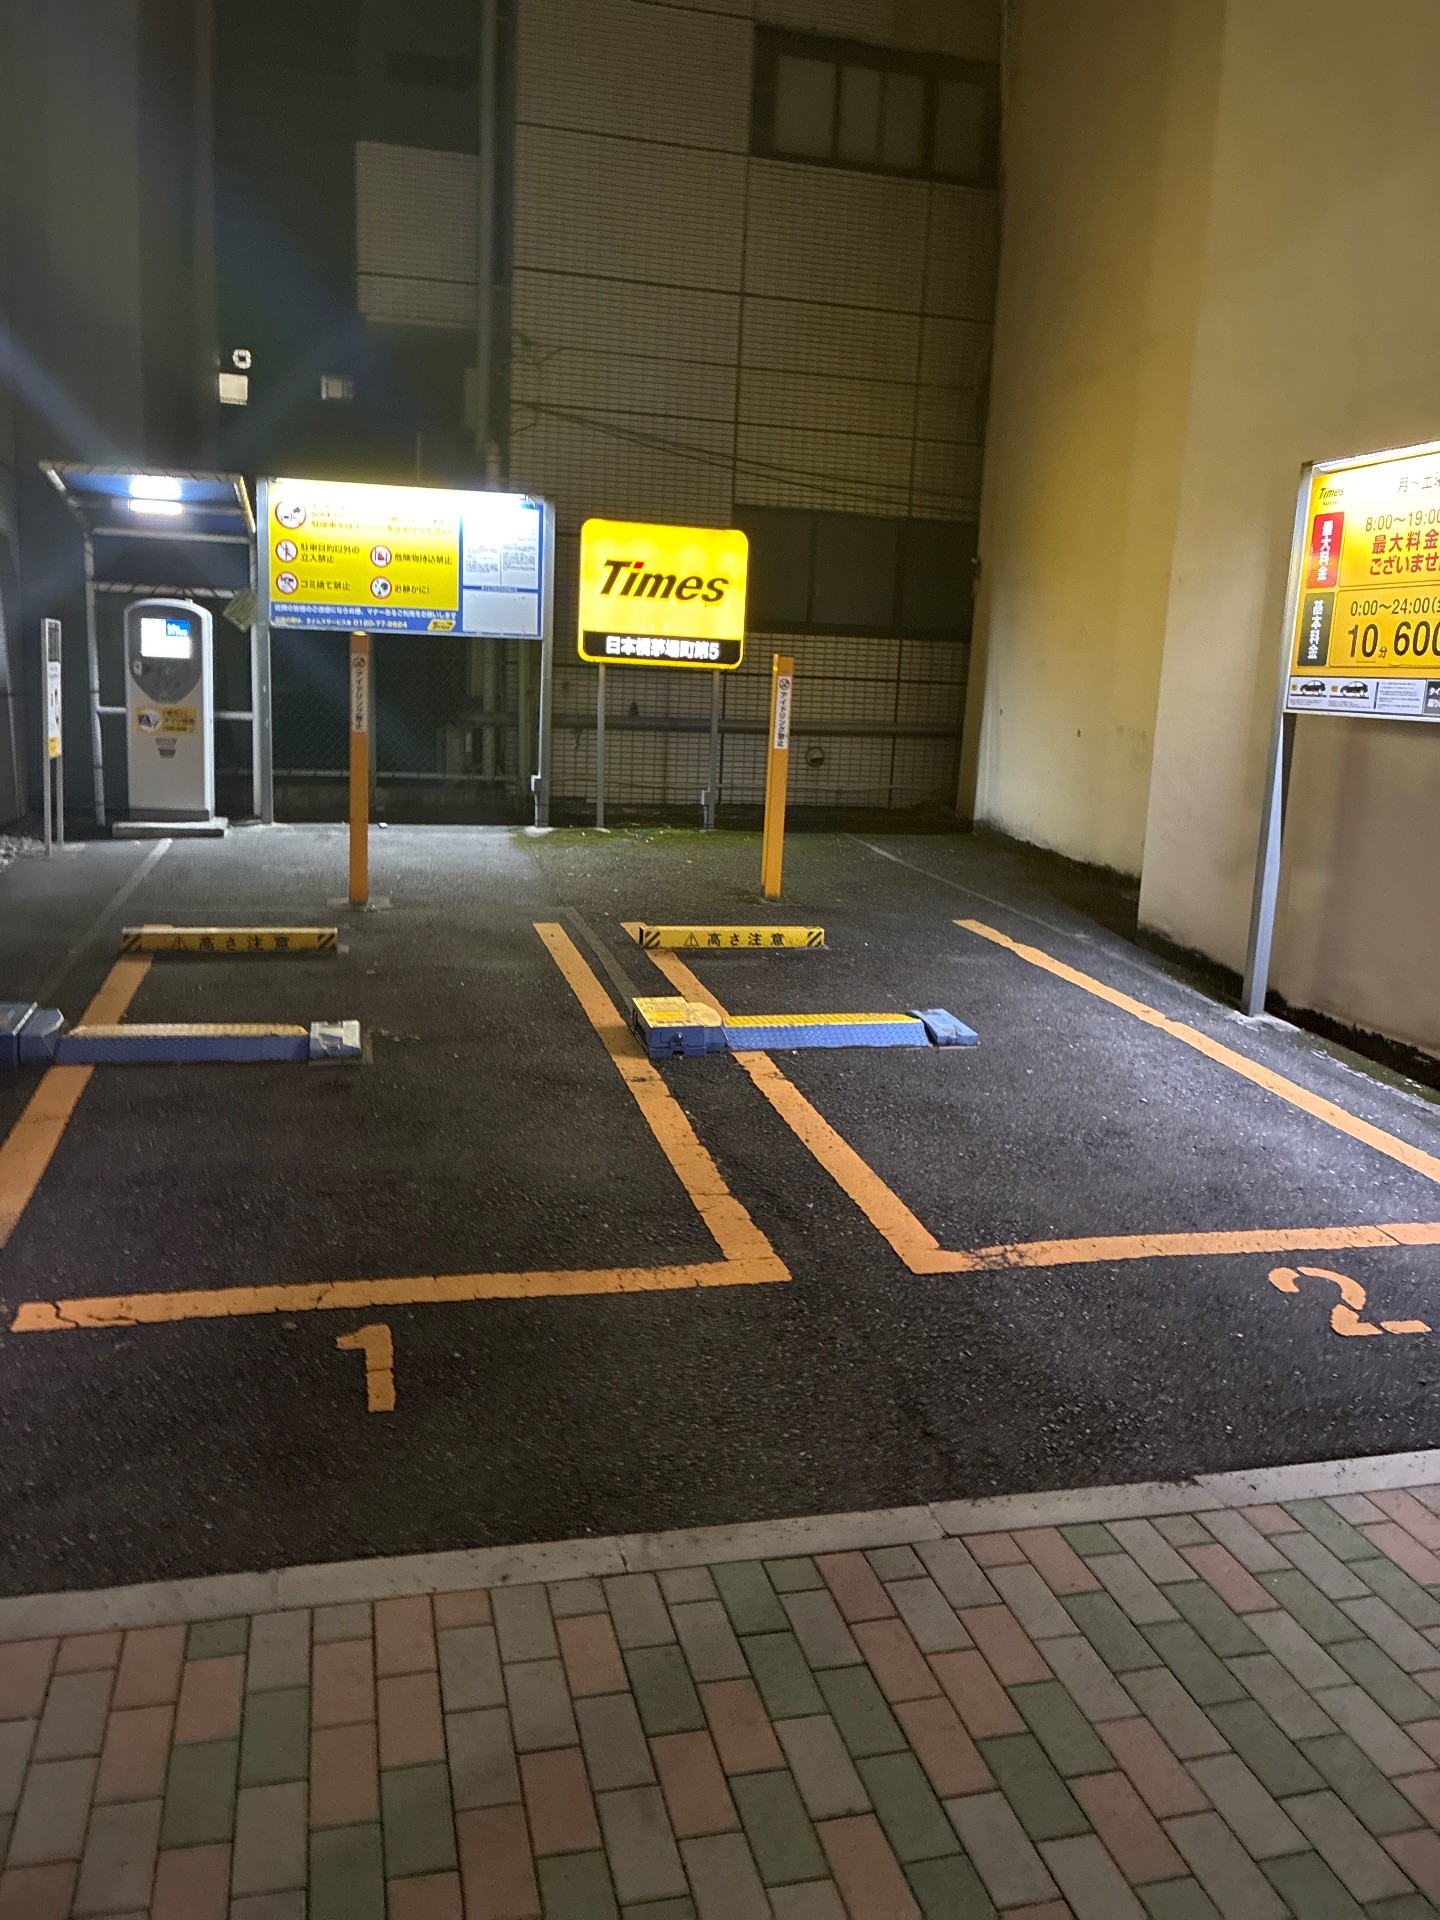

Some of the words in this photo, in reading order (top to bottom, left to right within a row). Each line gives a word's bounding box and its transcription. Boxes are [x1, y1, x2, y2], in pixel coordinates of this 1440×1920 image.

[1319, 487, 1345, 500] Times
[1317, 519, 1334, 581] 最大料金
[1372, 528, 1440, 554] 最大料金
[1370, 552, 1440, 576] ございませ
[599, 558, 730, 604] Times
[1351, 596, 1440, 616] 0:00～24:00(
[1307, 599, 1324, 660] 基本料金
[200, 936, 291, 951] 高さ注意
[707, 932, 785, 947] 高さ注意
[1267, 1266, 1432, 1336] 2
[335, 1323, 397, 1413] 1
